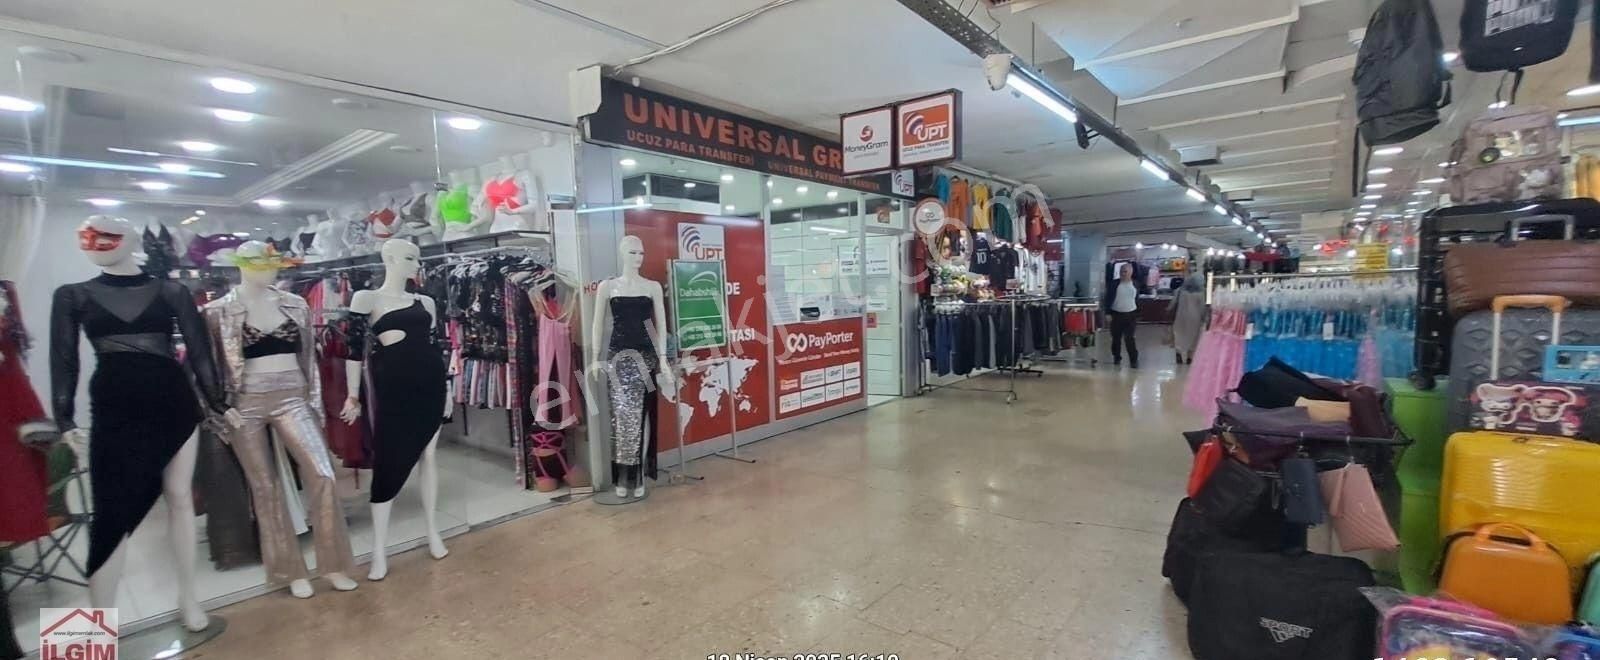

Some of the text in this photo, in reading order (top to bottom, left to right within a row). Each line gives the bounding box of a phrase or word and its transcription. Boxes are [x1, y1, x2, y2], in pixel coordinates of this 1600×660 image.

[623, 93, 805, 161] UNIVERSAL
[917, 124, 948, 141] UPT
[626, 129, 663, 147] UCUZ
[665, 139, 696, 154] PARA
[845, 141, 889, 153] MoneyGram
[695, 246, 722, 261] UPT
[976, 251, 987, 264] 10
[808, 332, 854, 350] PayPorter
